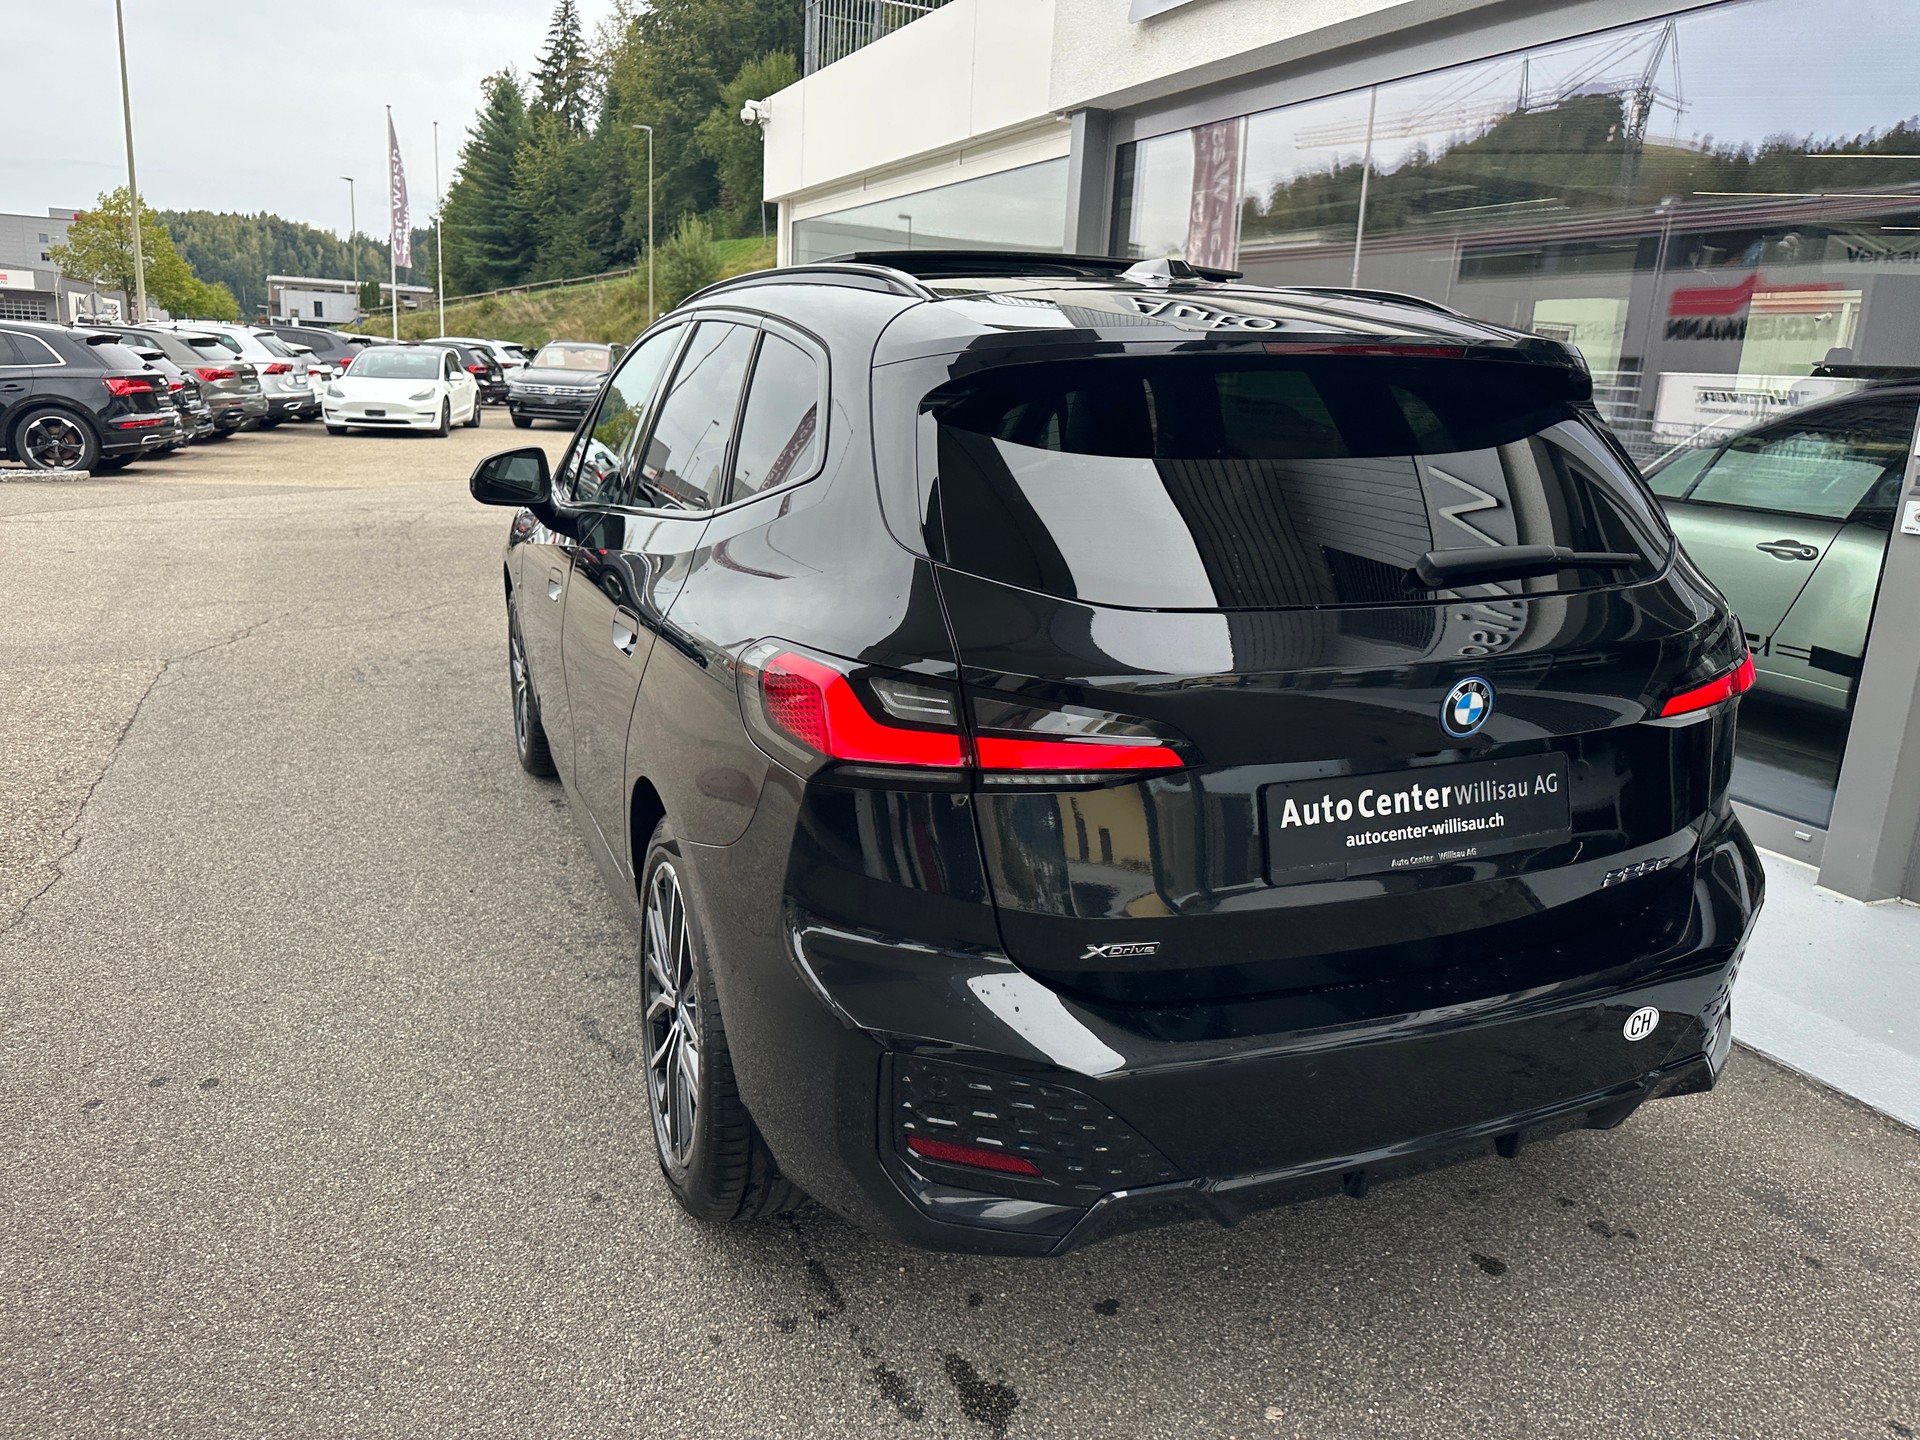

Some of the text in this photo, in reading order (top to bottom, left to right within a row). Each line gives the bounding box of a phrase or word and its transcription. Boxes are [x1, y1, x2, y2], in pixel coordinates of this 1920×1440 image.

[391, 148, 402, 255] Car-Wash
[1452, 682, 1489, 701] BMW
[1280, 772, 1558, 829] Auto Center Willisau AG
[1346, 812, 1505, 847] autocenter-willisau.ch
[1391, 848, 1477, 868] Auto Center Willisau AG
[1631, 1012, 1652, 1036] CH
